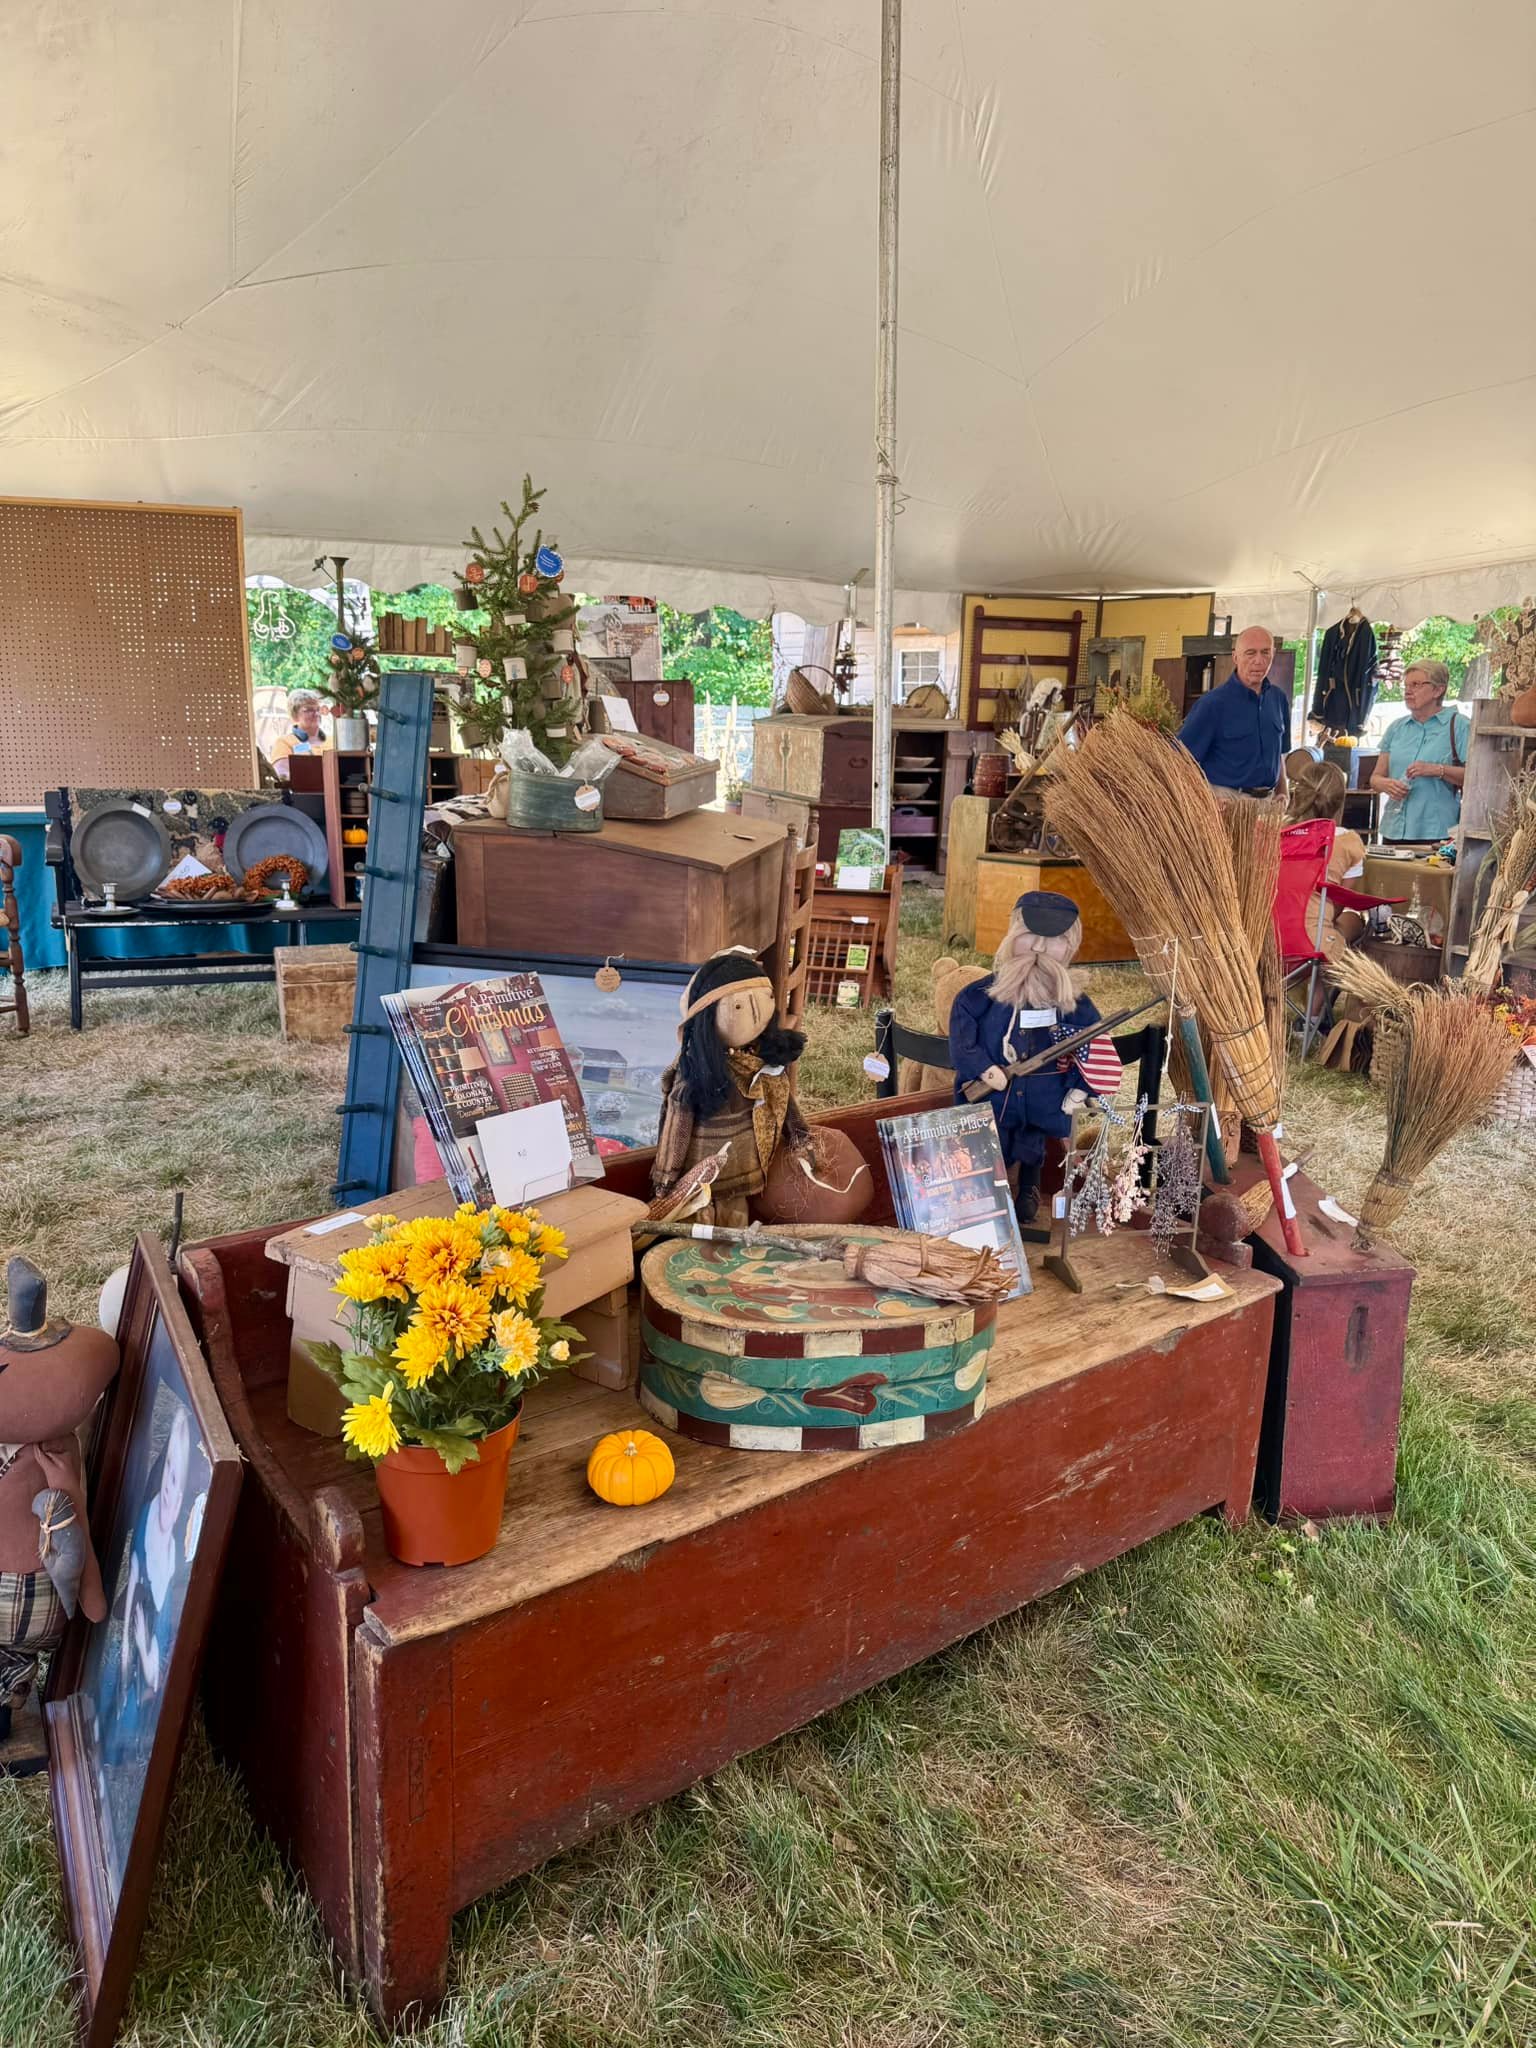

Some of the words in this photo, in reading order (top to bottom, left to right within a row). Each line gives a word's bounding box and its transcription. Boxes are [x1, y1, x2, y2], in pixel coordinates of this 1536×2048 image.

[479, 988, 534, 1005] Primitive
[445, 1003, 546, 1038] Christmas
[450, 1080, 485, 1092] PRIMITIVE
[453, 1089, 487, 1100] COLONIAL
[462, 1096, 493, 1108] COUNTRY
[903, 1129, 912, 1144] A
[912, 1122, 958, 1141] Primitive
[960, 1116, 989, 1131] Place
